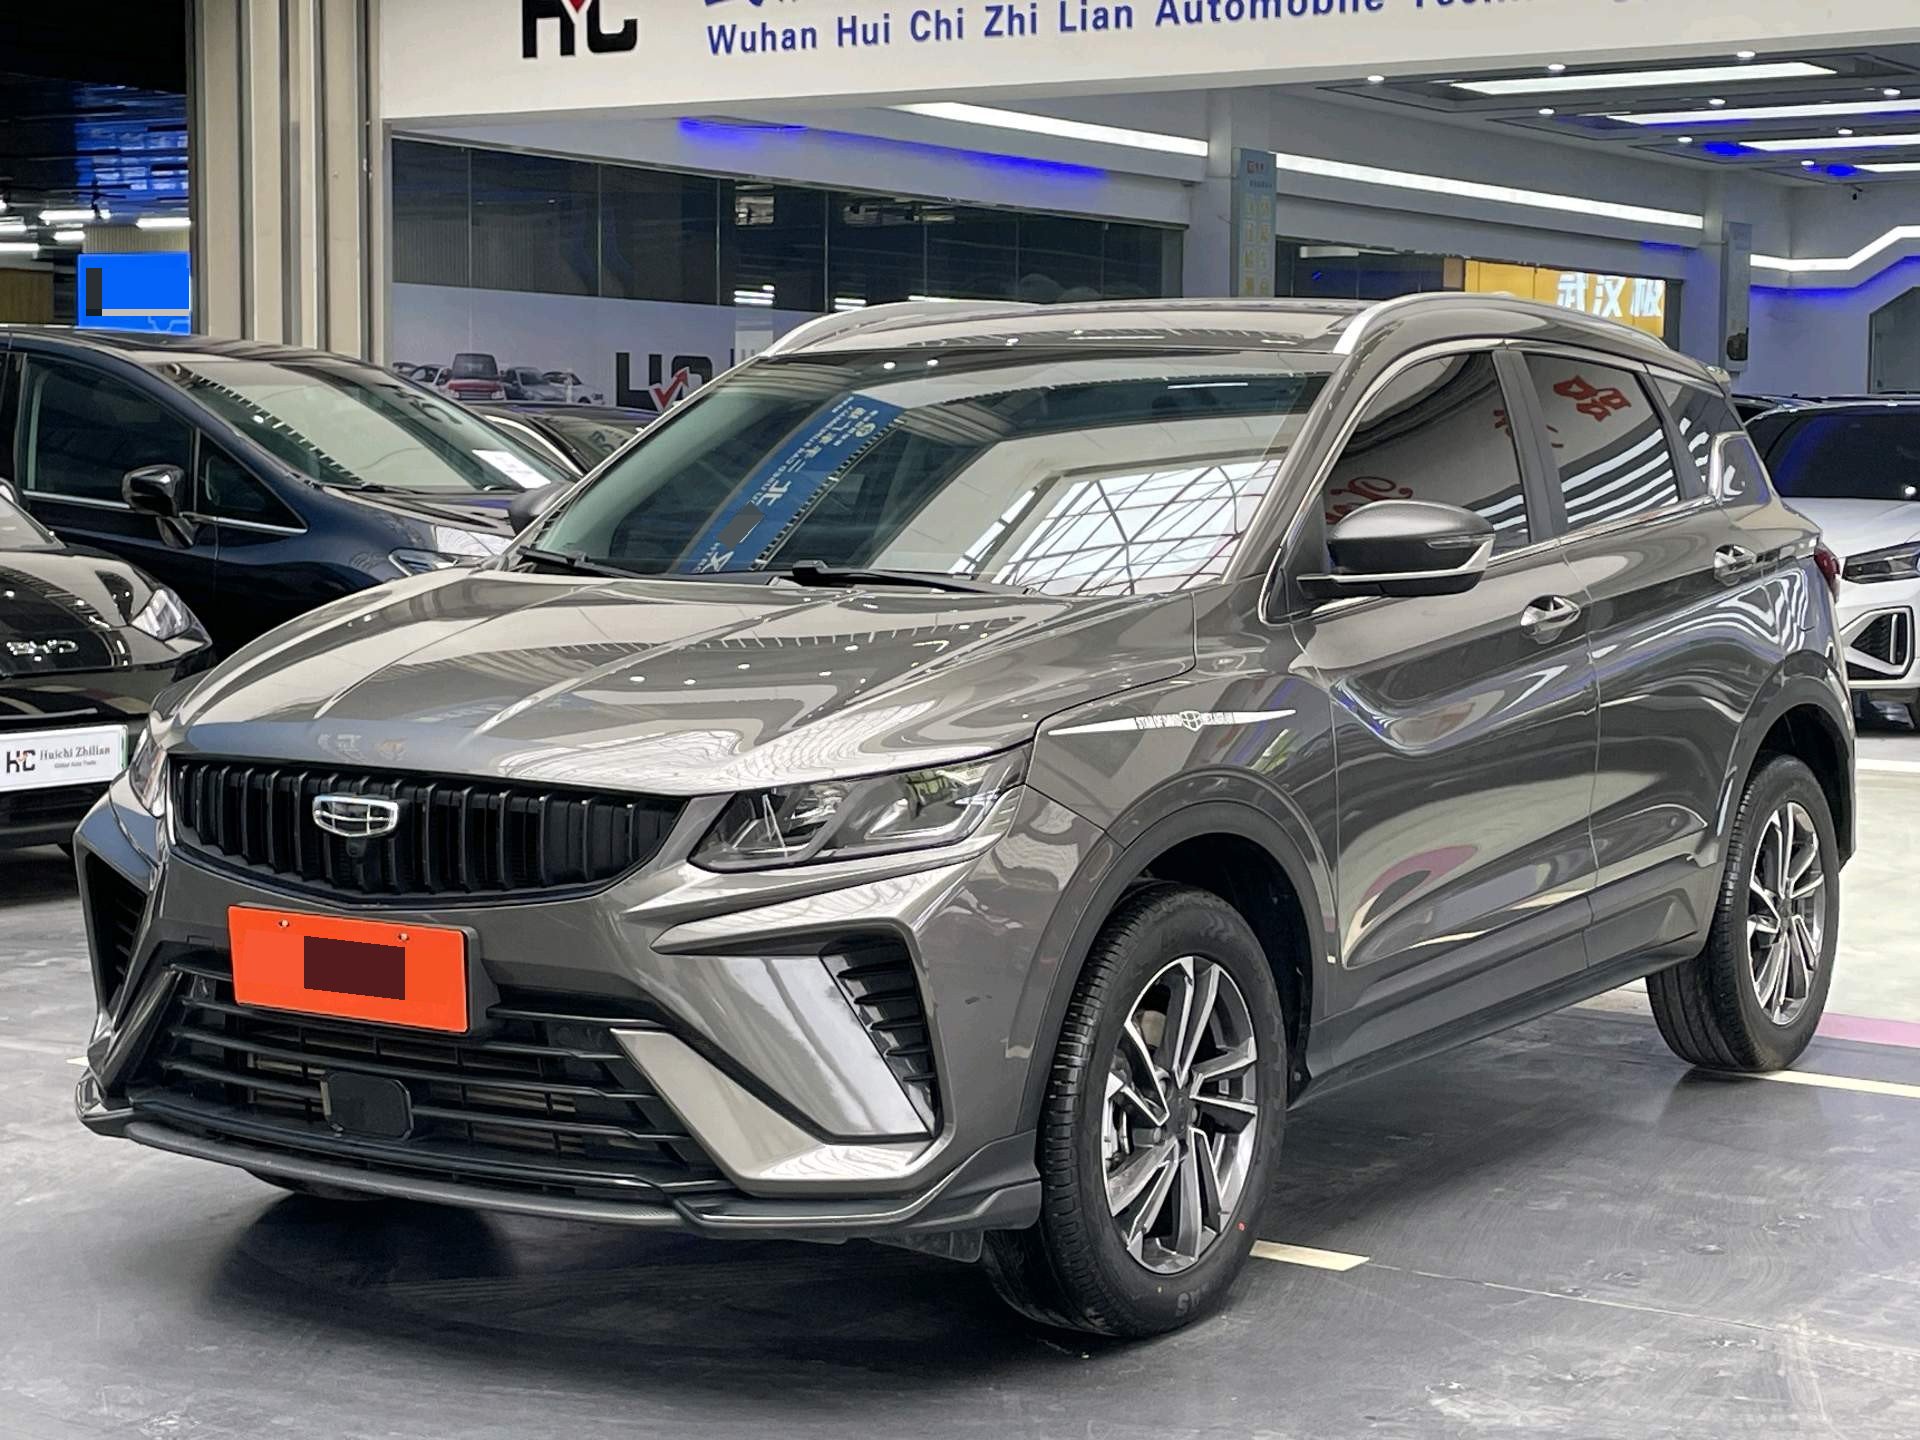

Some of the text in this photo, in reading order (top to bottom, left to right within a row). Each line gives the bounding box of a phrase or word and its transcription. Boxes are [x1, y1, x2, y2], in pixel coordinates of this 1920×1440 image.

[707, 22, 817, 55] Wuhan
[837, 13, 890, 47] Hui
[910, 7, 964, 42] Chi
[983, 3, 1038, 37] Zhi
[1059, 0, 1133, 32] Lian
